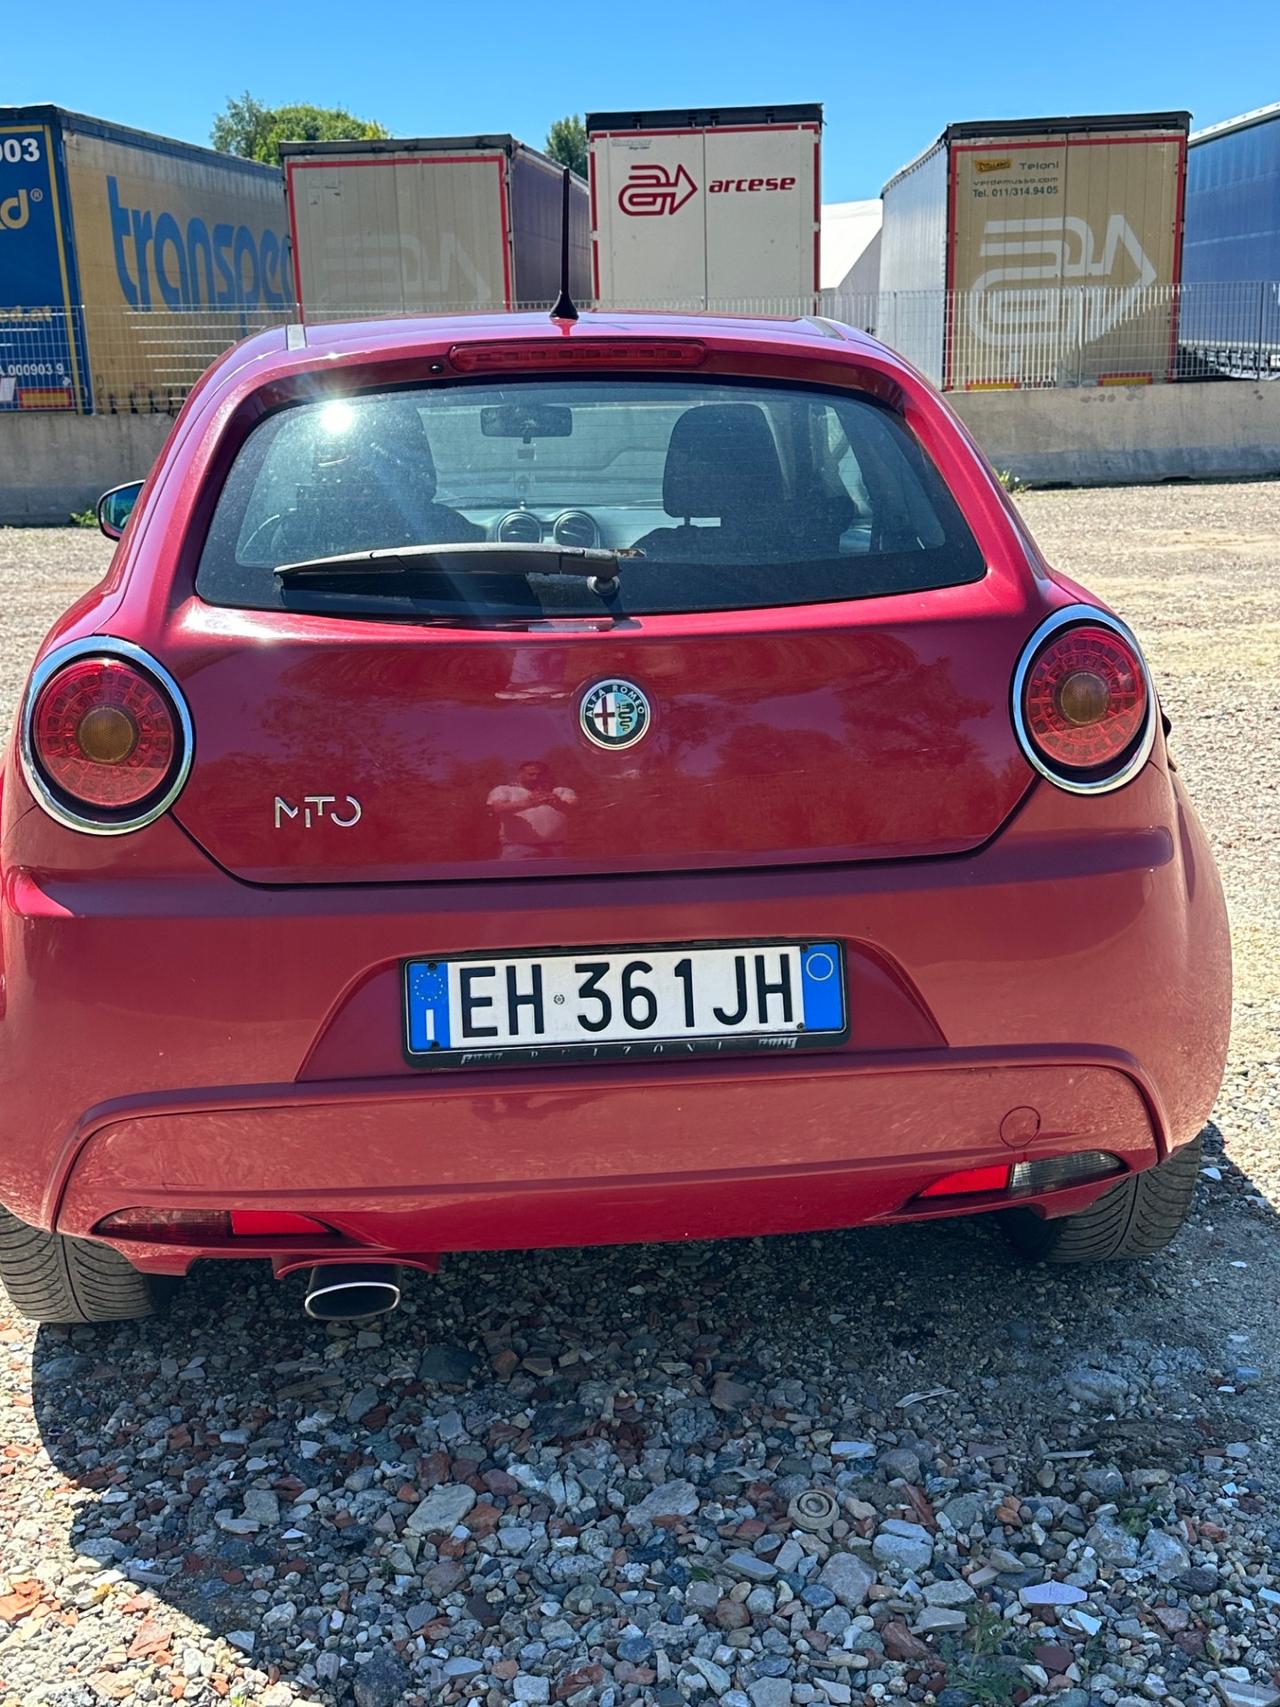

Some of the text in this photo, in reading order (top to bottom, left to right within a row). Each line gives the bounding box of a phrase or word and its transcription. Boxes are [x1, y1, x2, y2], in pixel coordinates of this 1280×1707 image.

[0, 138, 40, 162] 03
[709, 177, 796, 193] arcese
[973, 189, 989, 198] Tel.
[586, 685, 645, 718] ALFA ROMEO
[459, 964, 545, 1038] EH
